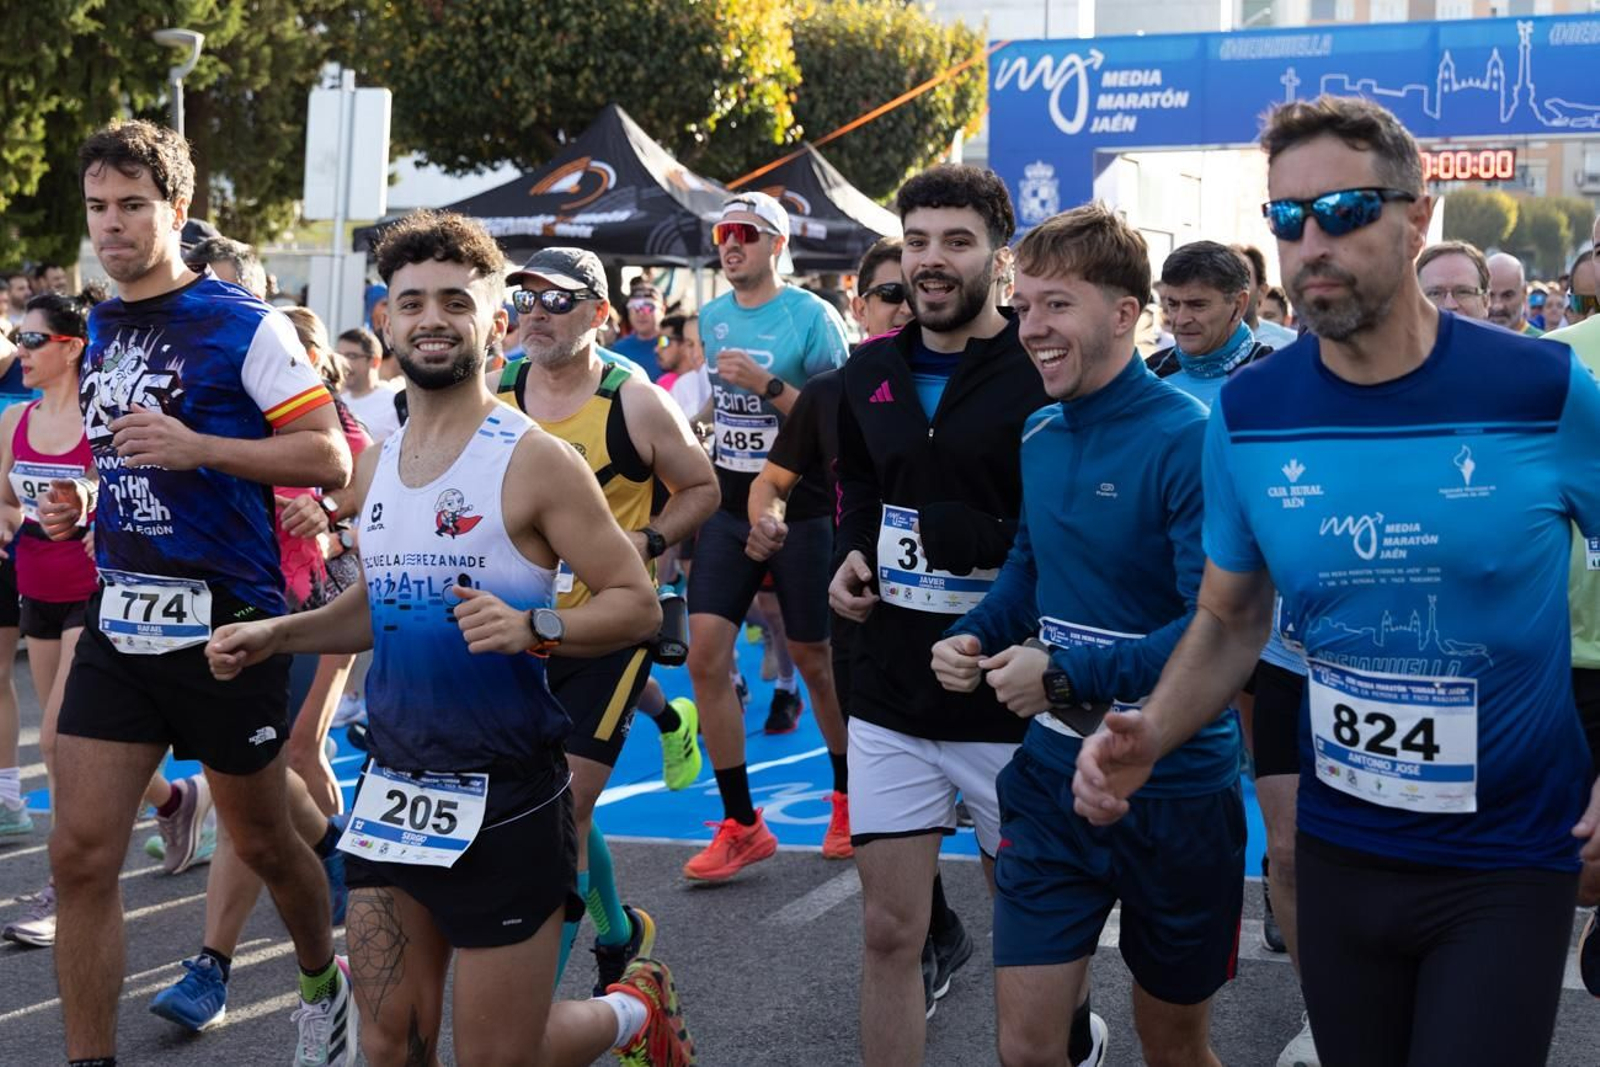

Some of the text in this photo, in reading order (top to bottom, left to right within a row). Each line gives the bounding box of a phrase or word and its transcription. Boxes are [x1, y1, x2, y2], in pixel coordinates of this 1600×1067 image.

[1101, 69, 1162, 87] MEDIA
[1096, 88, 1190, 110] MARATÓN
[1089, 113, 1138, 133] JAÉN
[722, 430, 765, 451] 485
[22, 480, 50, 500] 95
[1290, 485, 1324, 497] RURAL
[1384, 523, 1421, 534] MEDIA
[1382, 534, 1439, 547] MARATÓN
[1379, 547, 1408, 560] JAÉN
[120, 591, 188, 623] 774
[137, 624, 163, 633] RAFAEL
[1333, 703, 1441, 762] 824
[1348, 751, 1392, 770] ANTONIO
[1395, 763, 1421, 776] JOSÉ
[379, 789, 459, 836] 205
